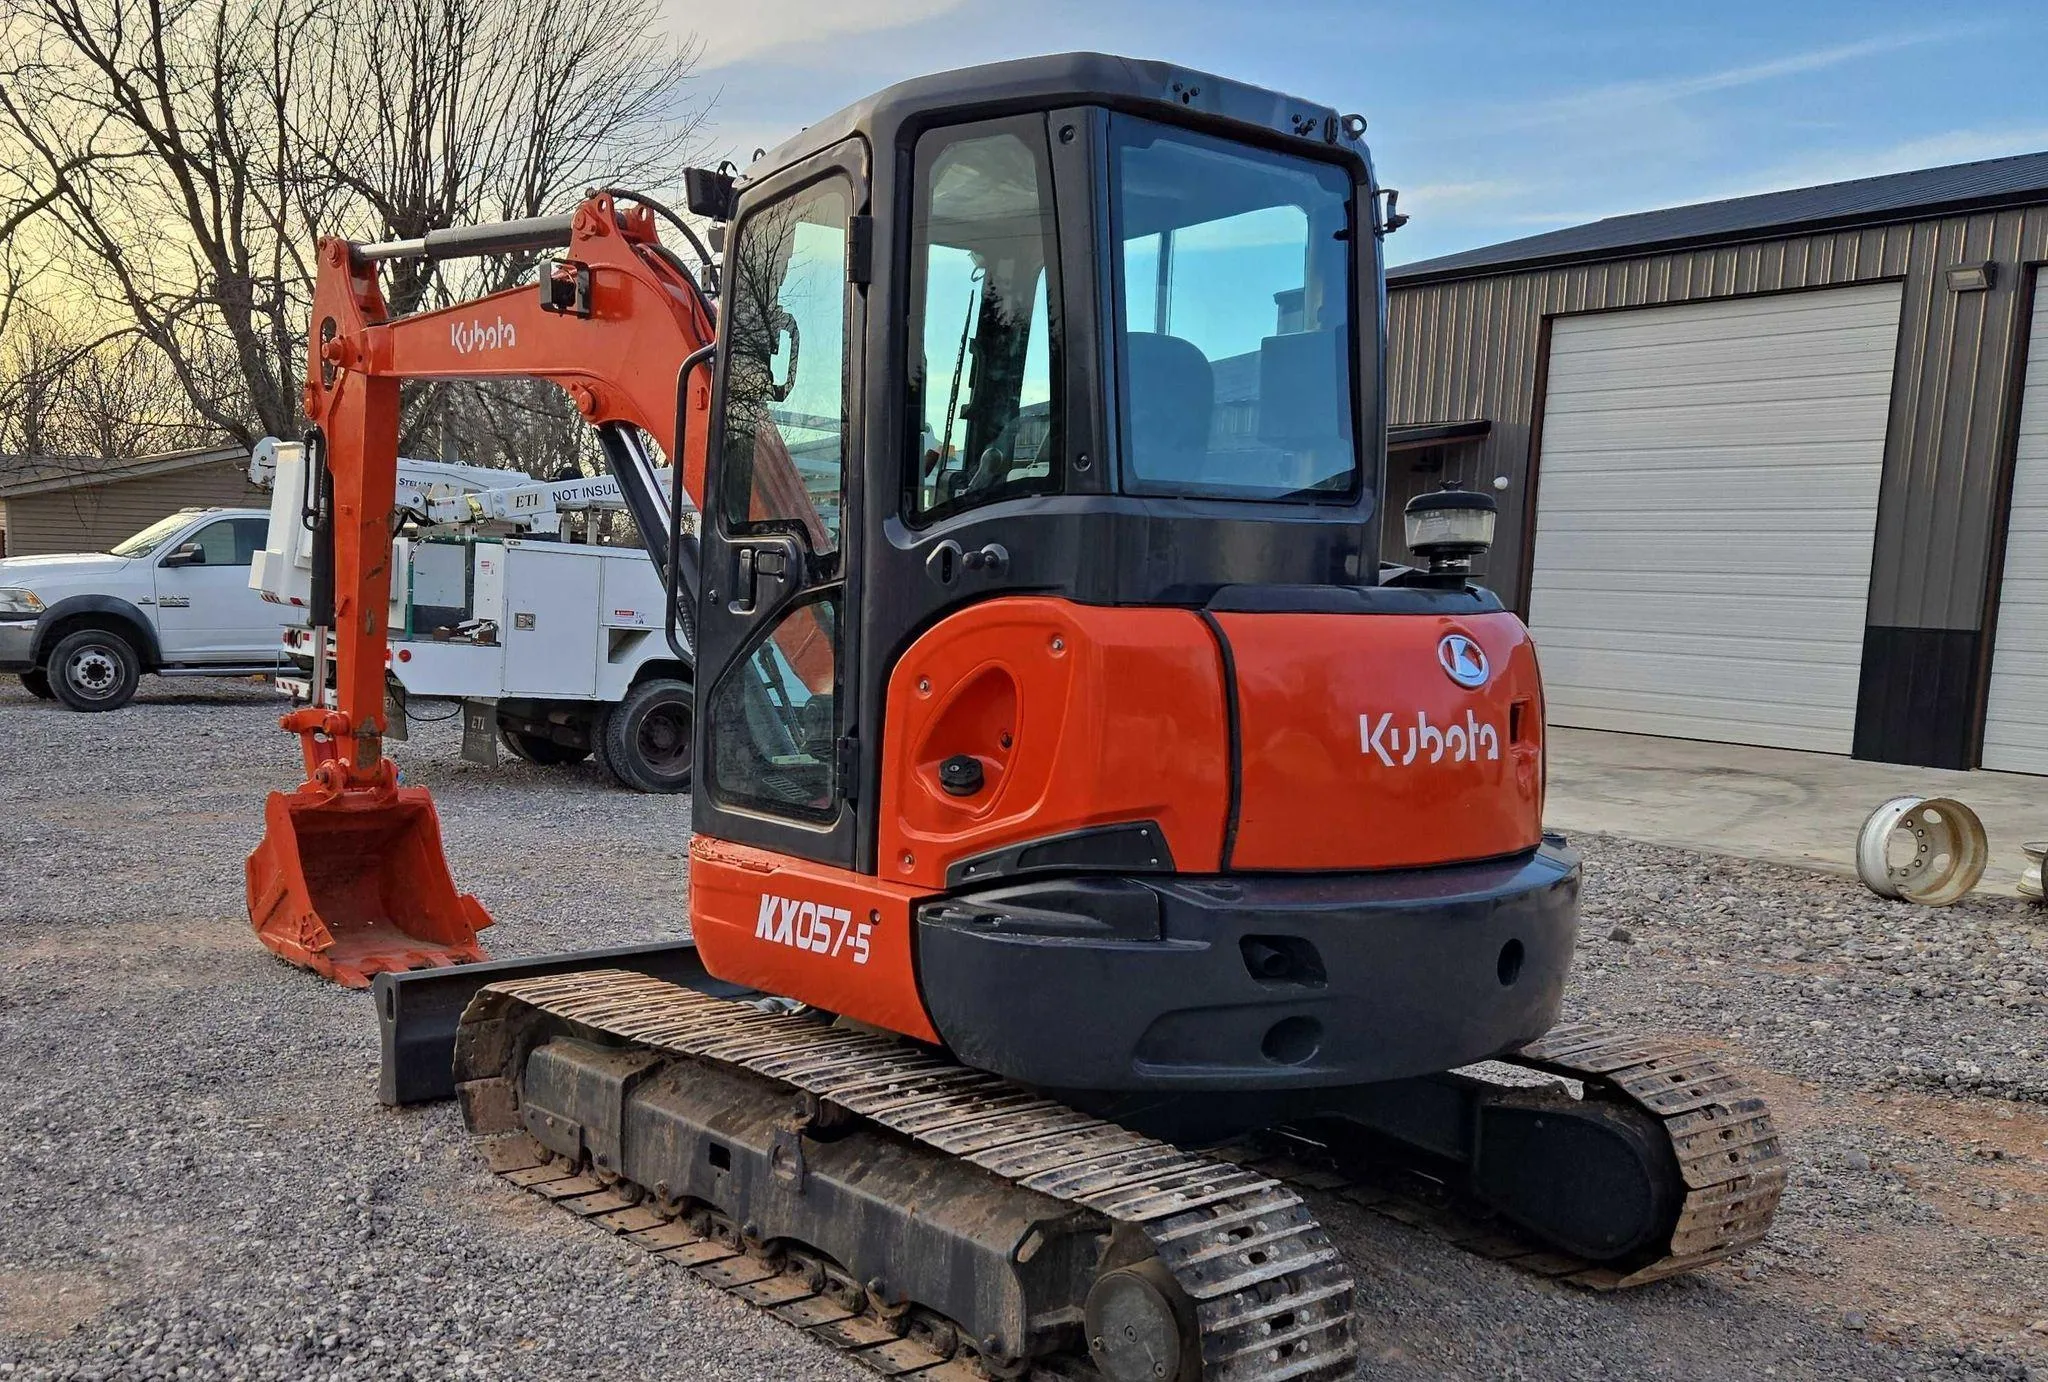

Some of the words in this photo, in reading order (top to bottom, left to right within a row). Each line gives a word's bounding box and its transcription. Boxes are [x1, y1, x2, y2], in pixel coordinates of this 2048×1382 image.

[451, 315, 516, 354] Kubota
[515, 493, 539, 509] ETI
[552, 488, 579, 503] NOT
[471, 715, 486, 730] ETI
[1358, 708, 1500, 768] Kubota
[754, 892, 873, 966] KX057-5
